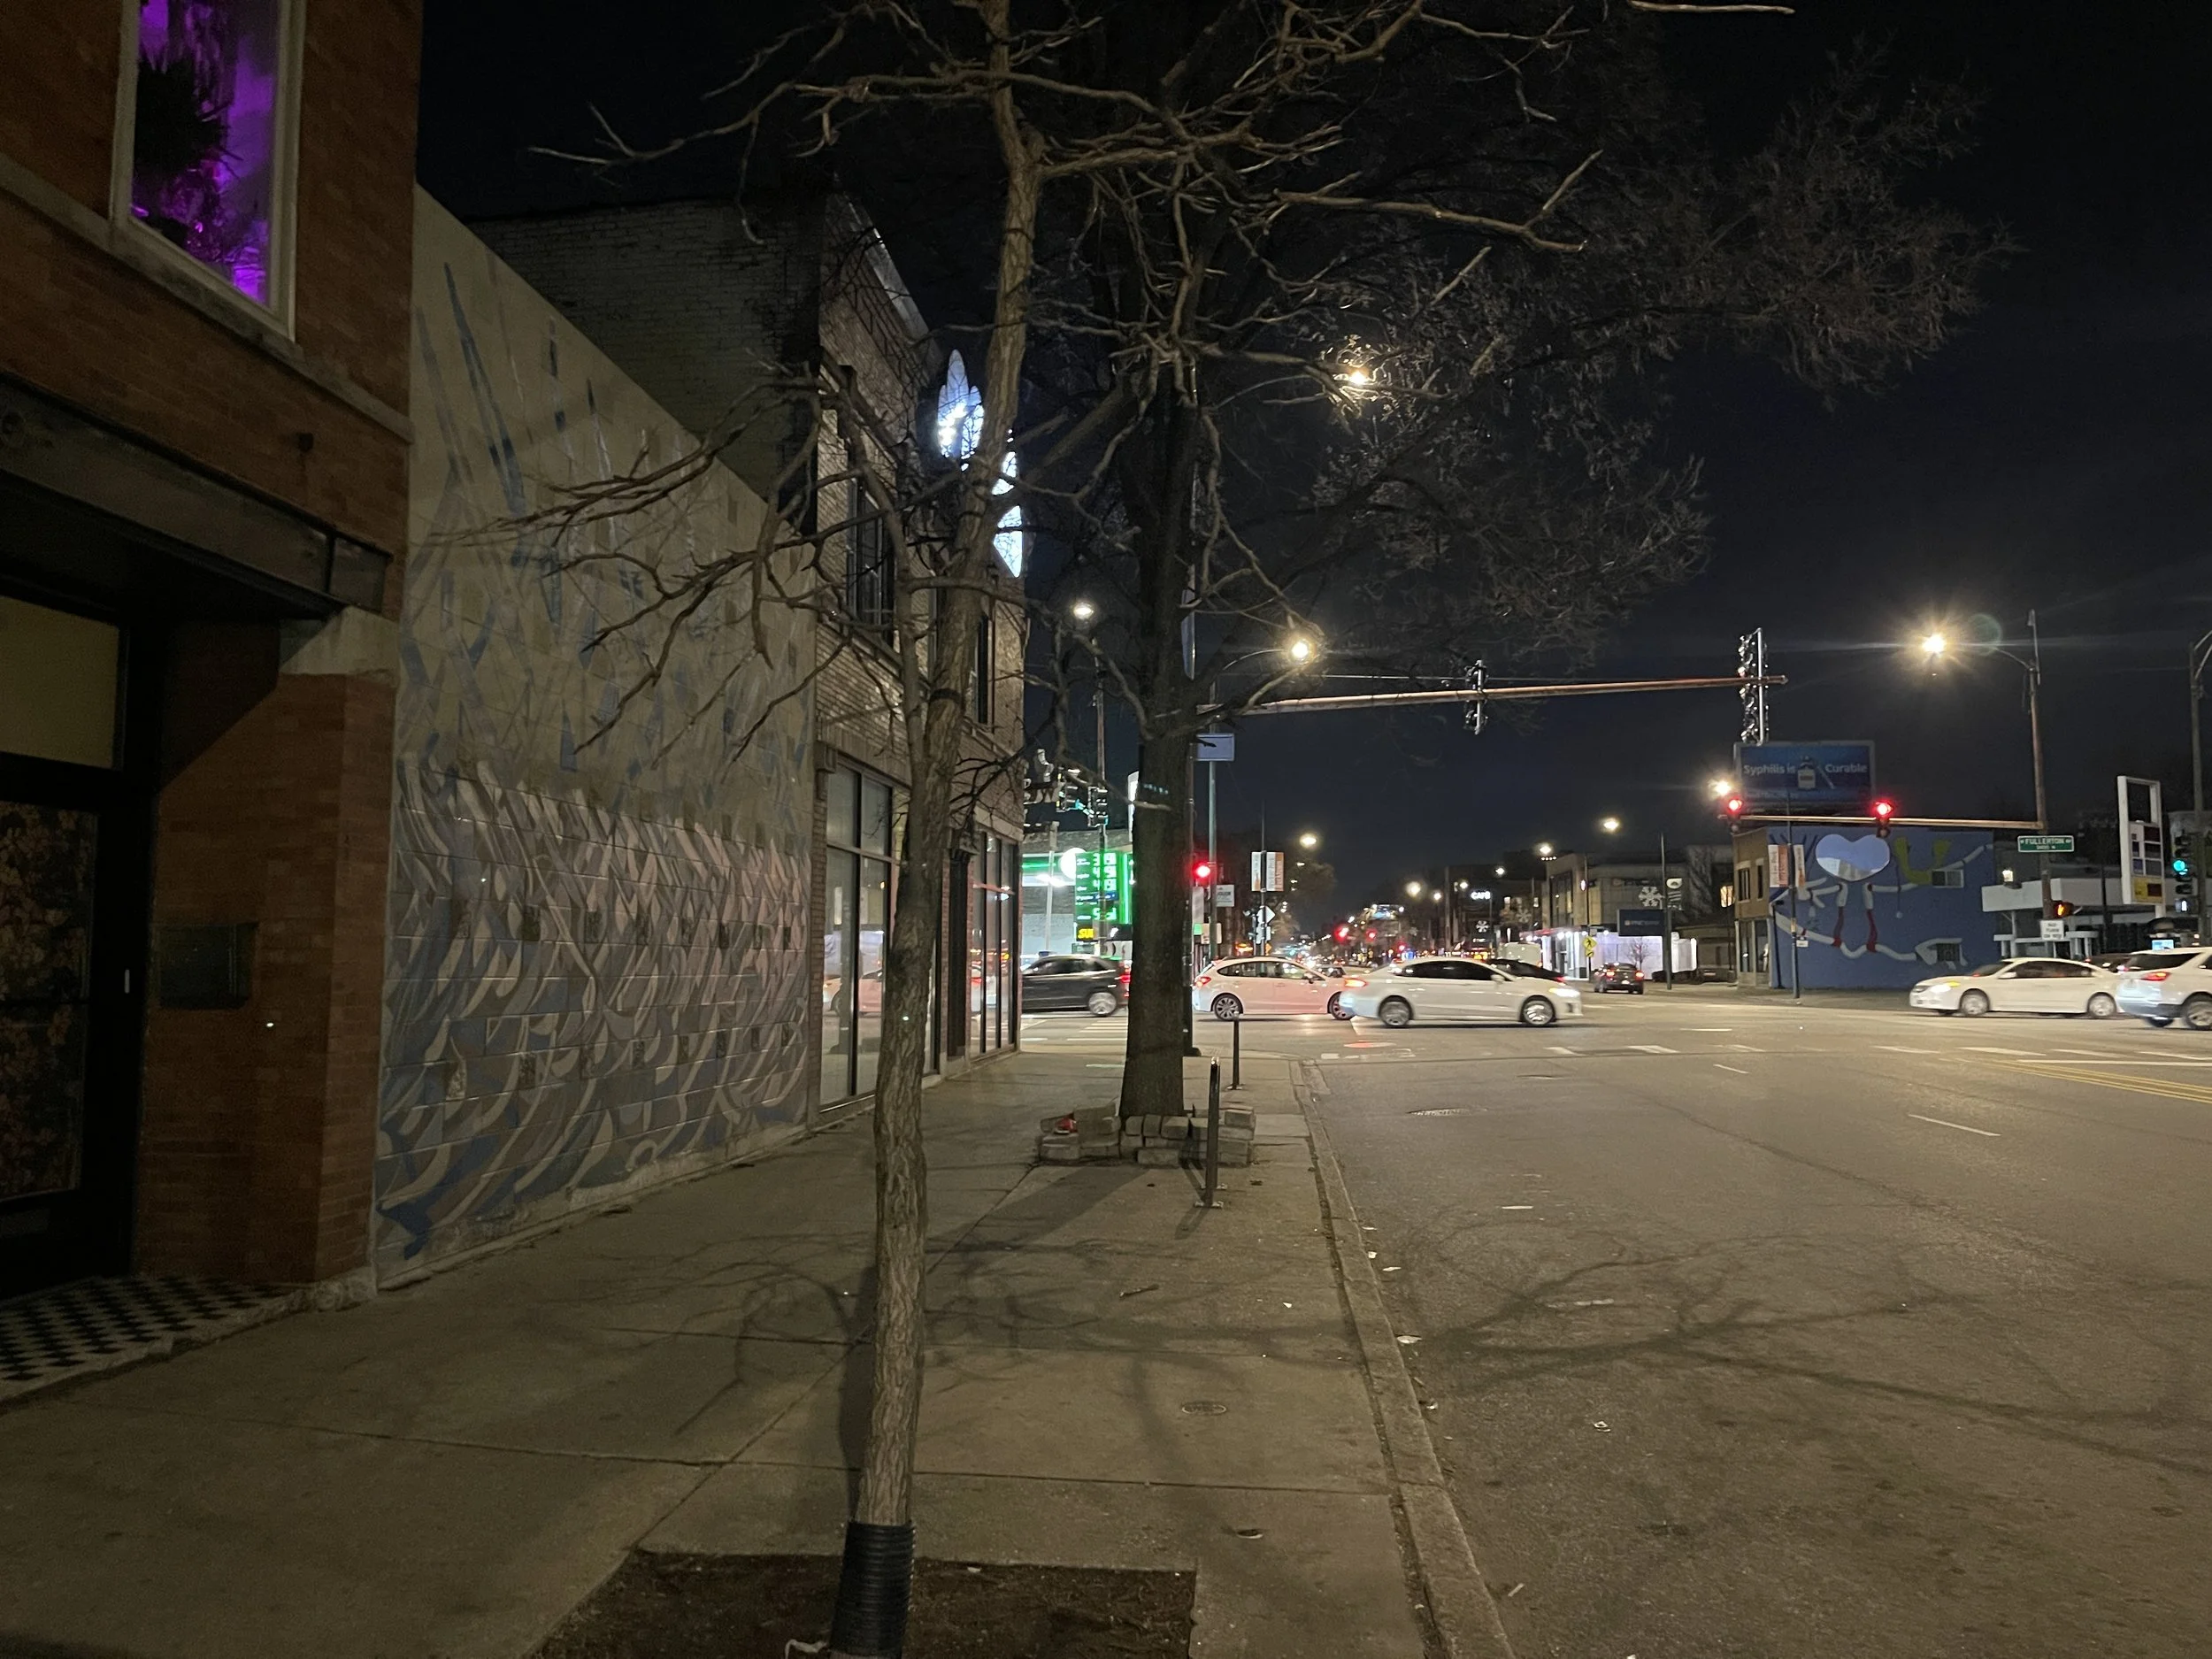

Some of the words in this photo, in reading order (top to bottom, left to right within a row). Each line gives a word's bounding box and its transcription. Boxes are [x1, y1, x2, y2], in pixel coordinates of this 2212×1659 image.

[1743, 764, 1785, 776] Syphilis
[1786, 764, 1795, 773] is
[1825, 764, 1868, 773] Curable
